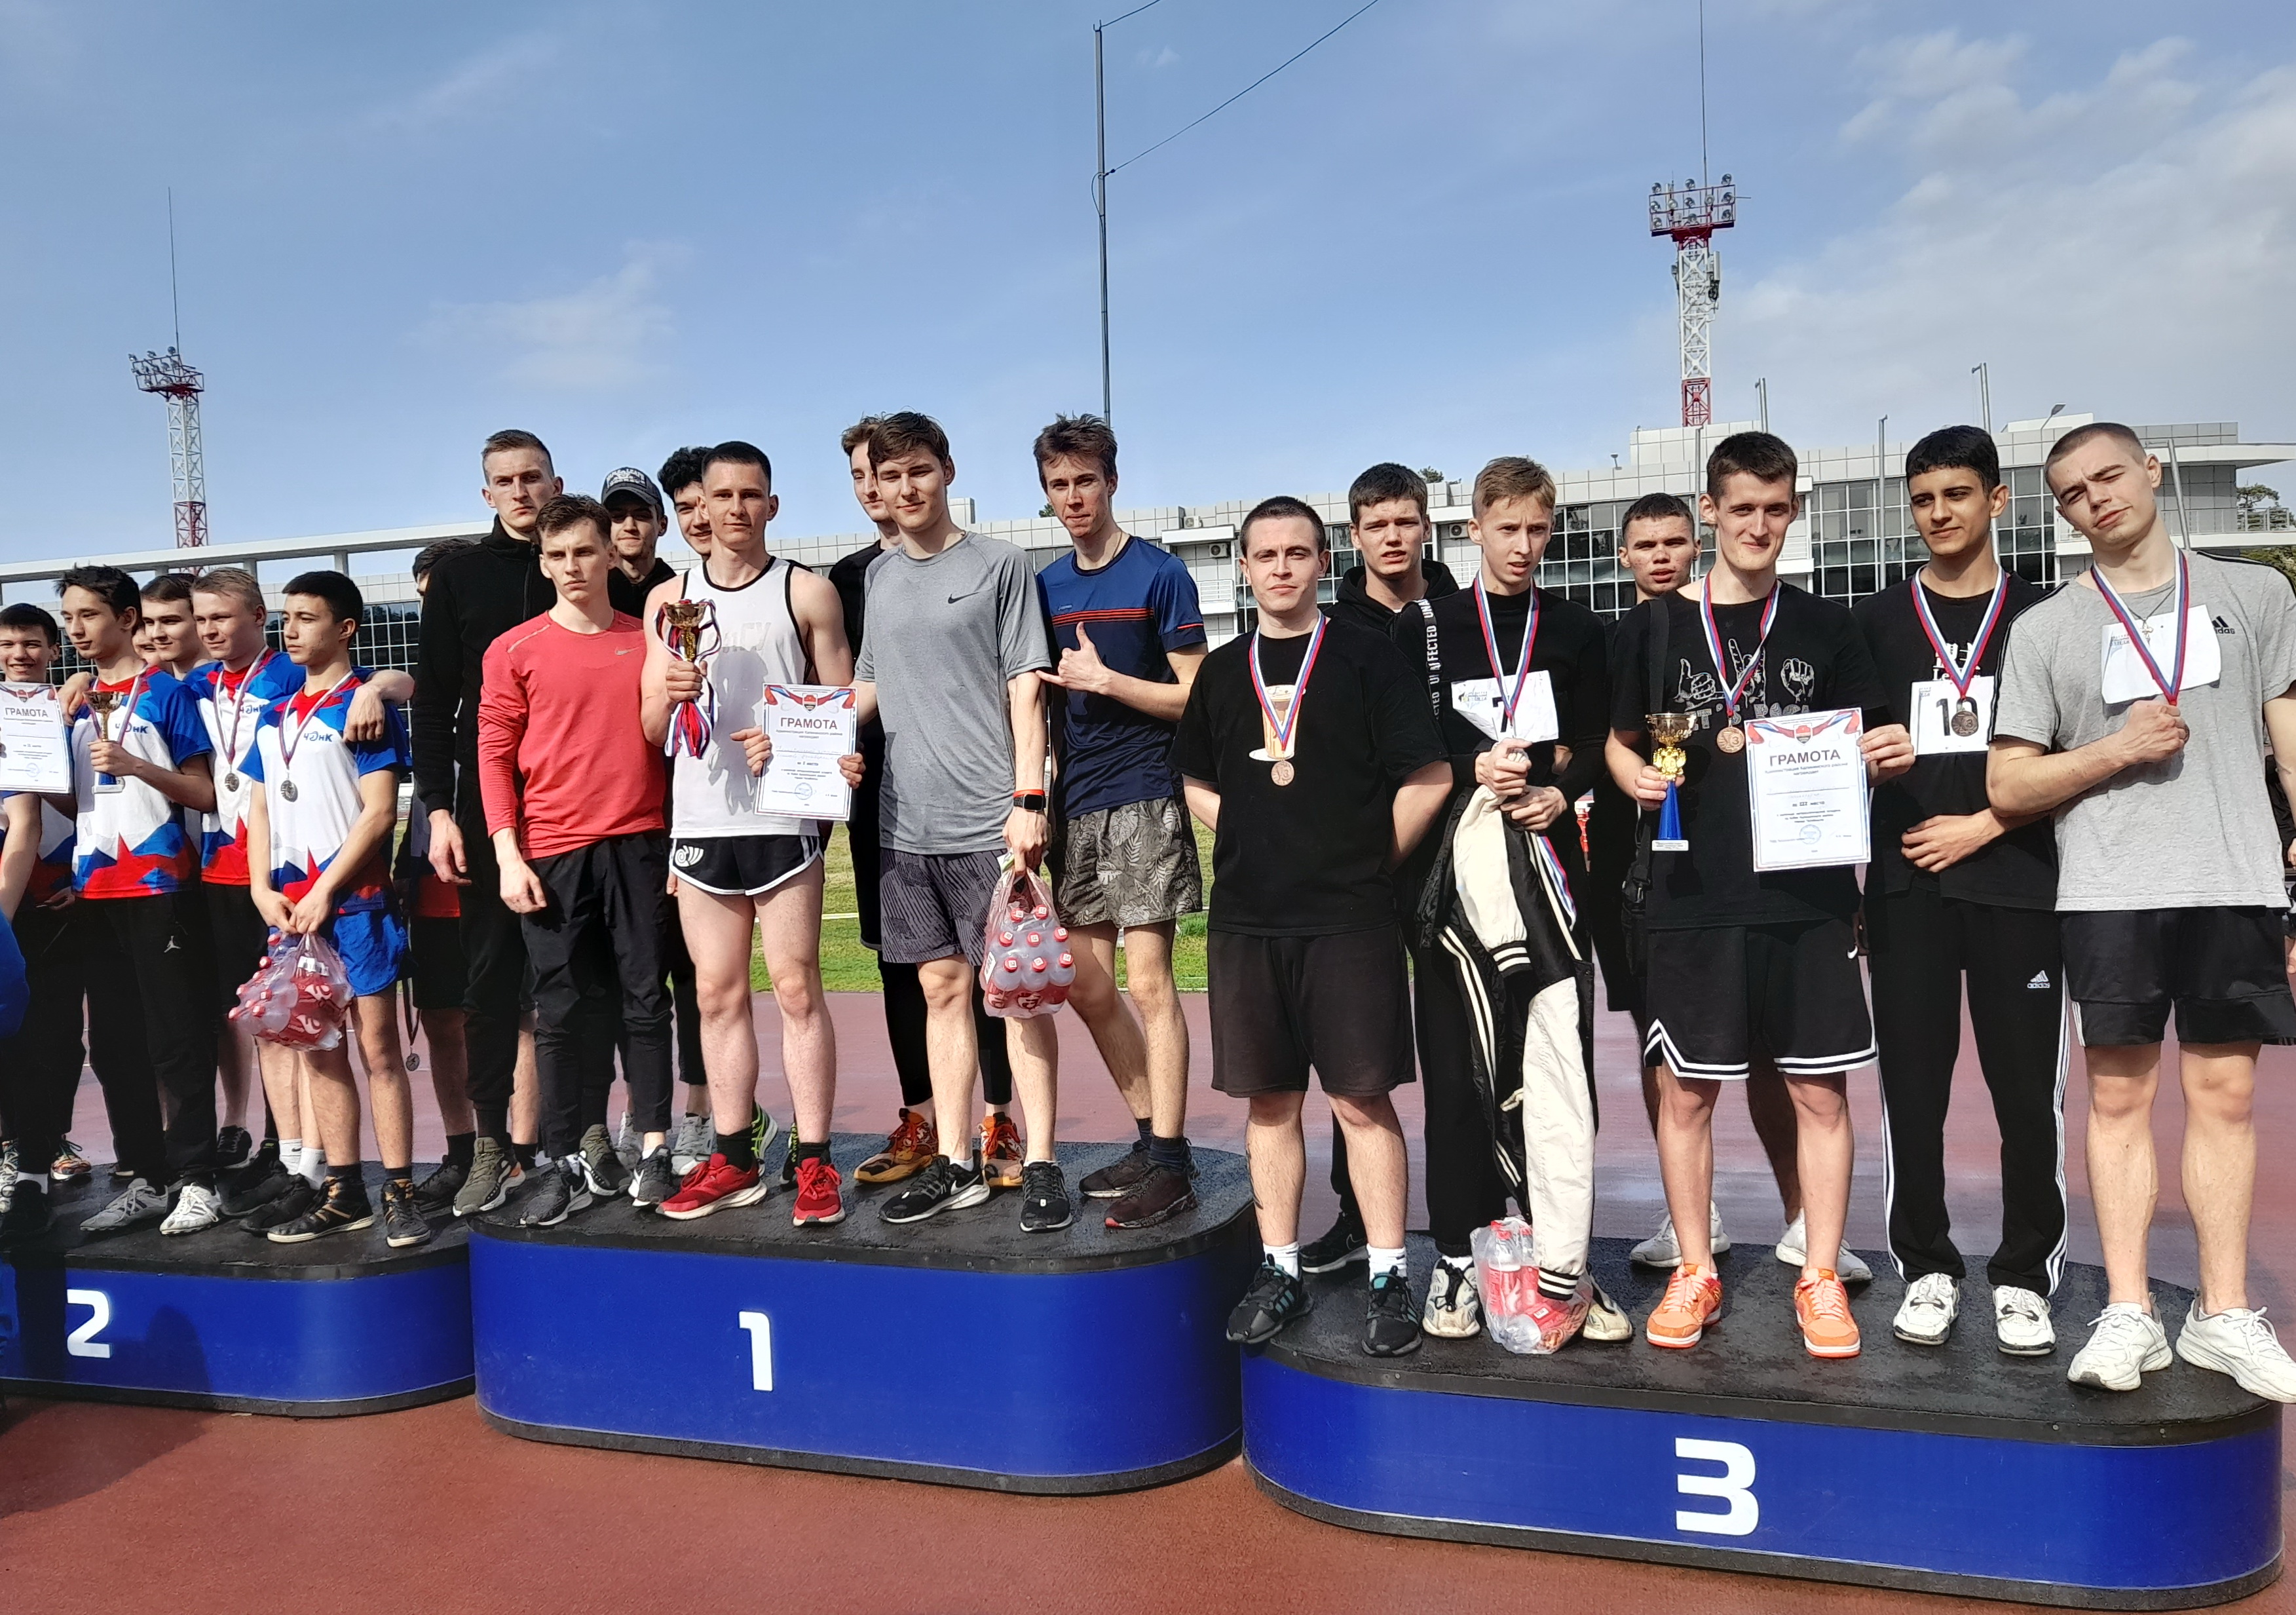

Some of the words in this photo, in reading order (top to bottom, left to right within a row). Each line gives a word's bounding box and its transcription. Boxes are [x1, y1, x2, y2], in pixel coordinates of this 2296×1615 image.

[5, 708, 48, 717] ГРАМОТА
[780, 717, 838, 729] ГРАМОТА
[1492, 695, 1510, 732] 7
[1770, 749, 1841, 767] ГРАМОТА
[67, 1289, 110, 1358] 2
[738, 1311, 773, 1391] 1
[1675, 1437, 1759, 1536] 3
